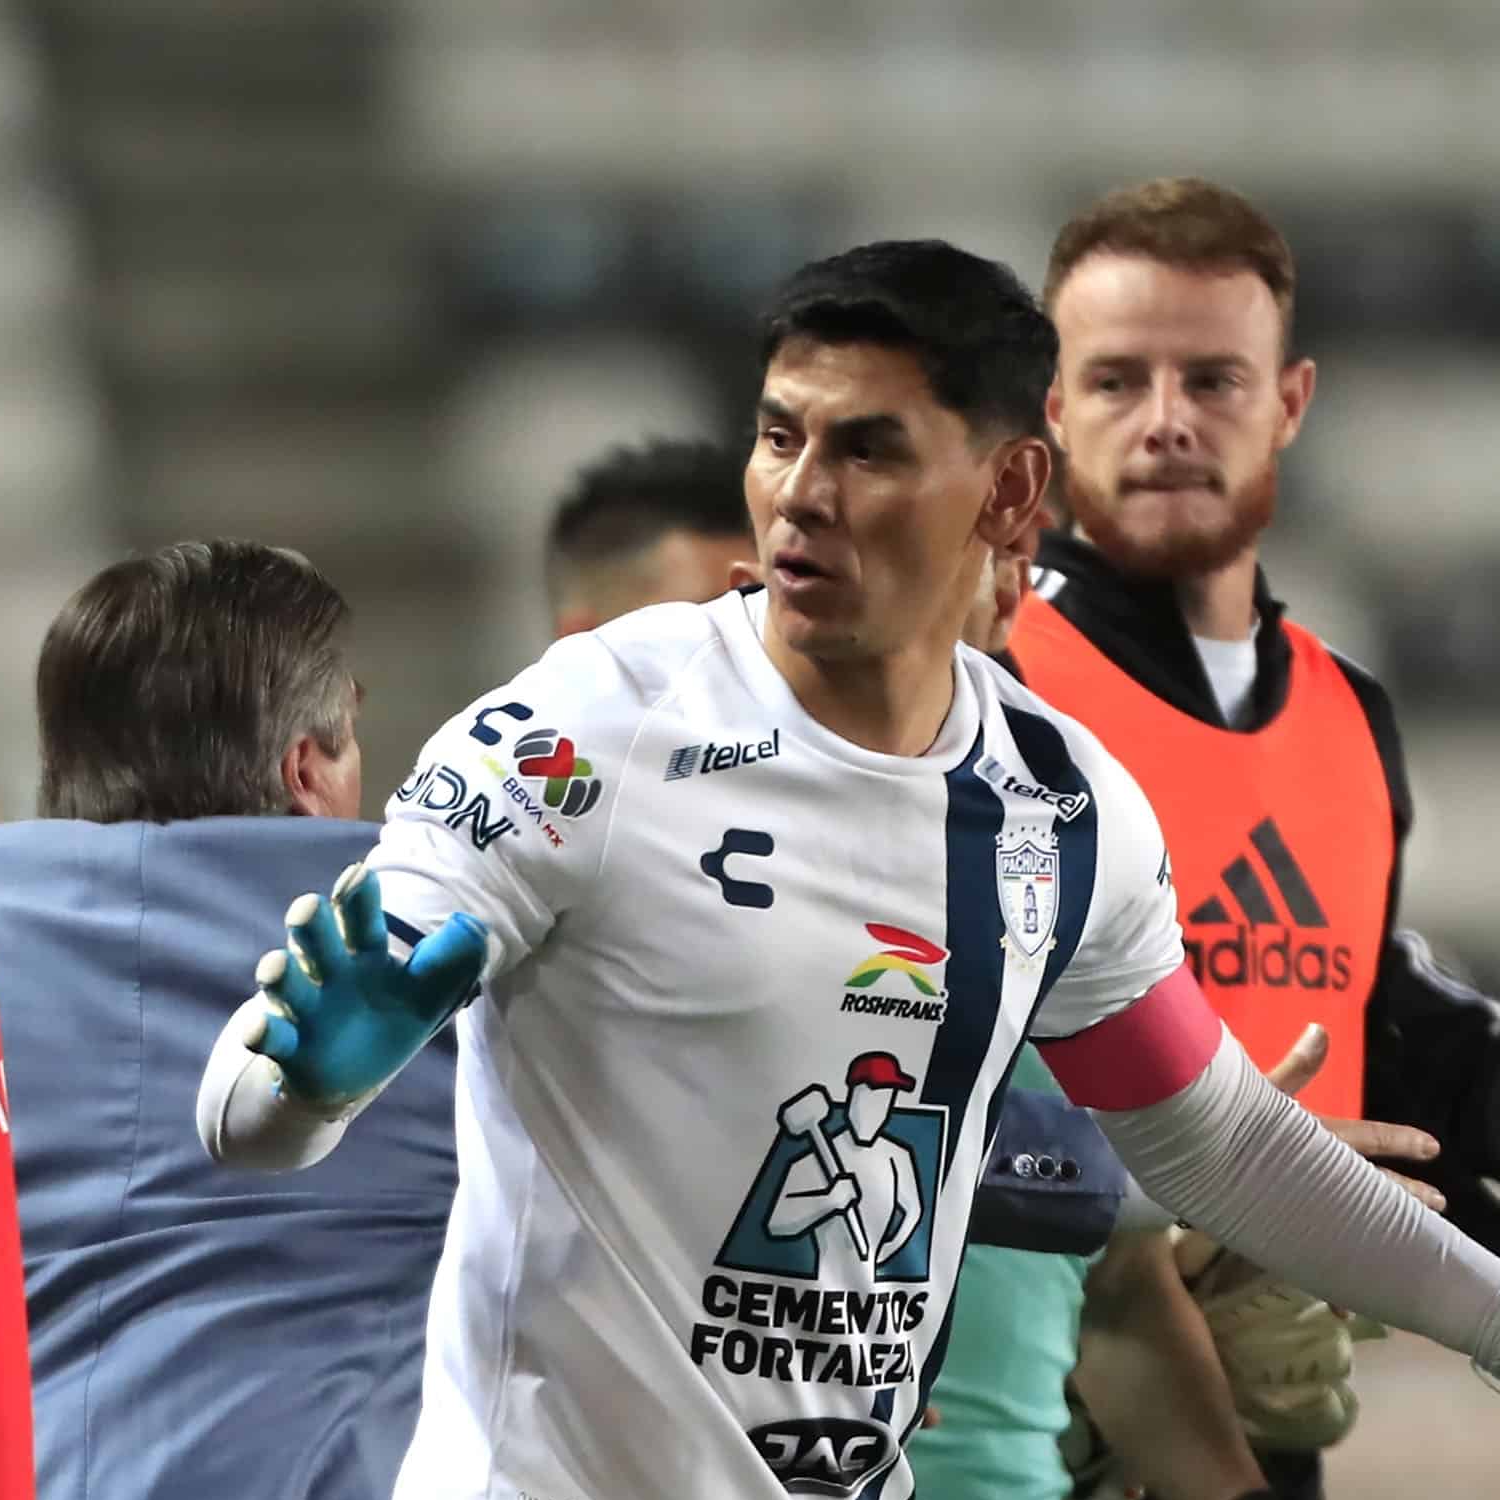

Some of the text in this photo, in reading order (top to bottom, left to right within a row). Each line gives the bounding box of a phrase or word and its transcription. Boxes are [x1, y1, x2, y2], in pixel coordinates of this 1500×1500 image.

[700, 727, 779, 774] telcel
[502, 777, 564, 849] BBVA MX
[1002, 775, 1087, 817] telcel
[1002, 854, 1054, 875] PACHUCA
[840, 992, 944, 1021] ROSHFRANS
[702, 1275, 930, 1336] CEMENTOS
[763, 1433, 878, 1475] JAC
